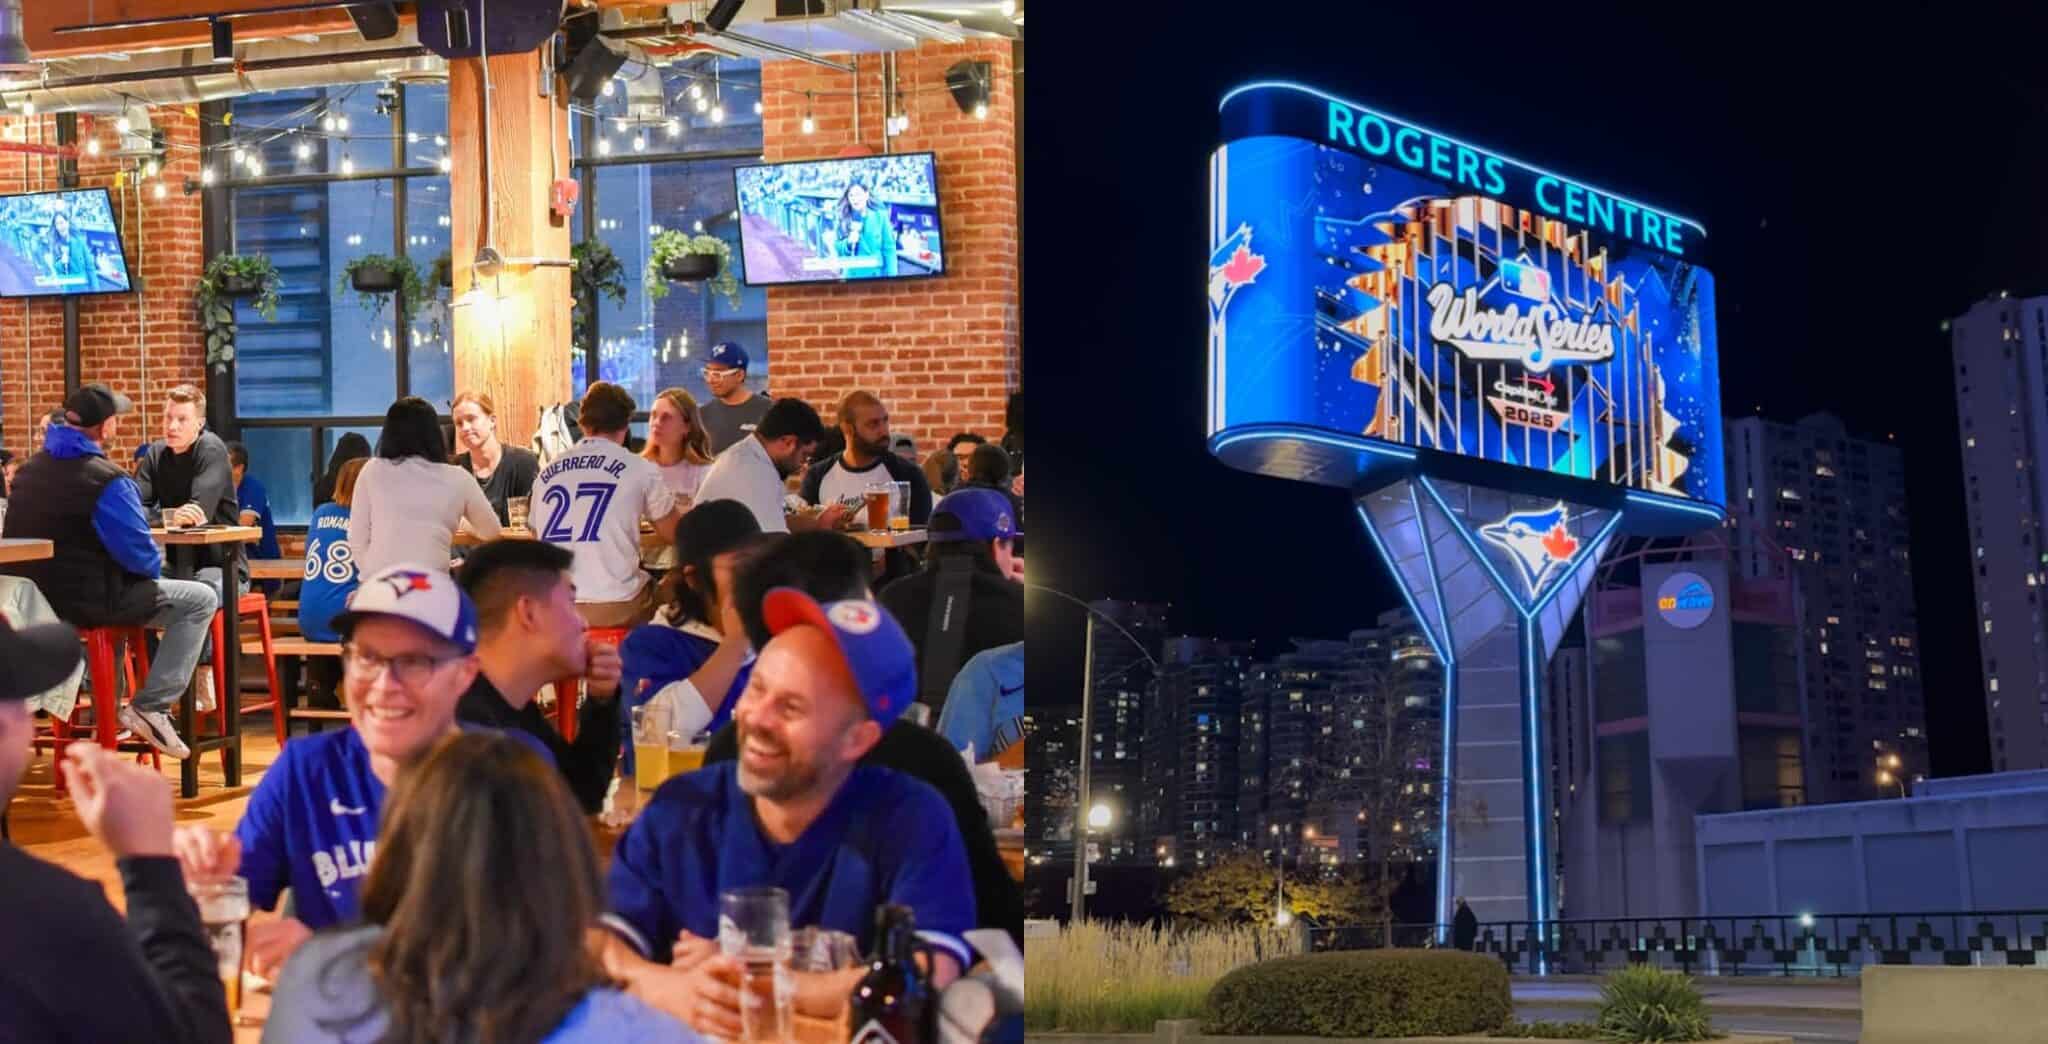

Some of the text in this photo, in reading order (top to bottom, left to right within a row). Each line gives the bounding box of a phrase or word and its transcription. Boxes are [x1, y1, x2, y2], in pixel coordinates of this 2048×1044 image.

[1328, 101, 1685, 254] ROGERS CENTRE
[1427, 283, 1616, 372] World Series
[1504, 405, 1553, 428] 2025
[540, 455, 627, 484] GUERRERO JR.
[317, 515, 351, 531] ROMAN
[542, 482, 618, 542] 27
[304, 537, 354, 584] 68
[311, 839, 377, 888] BLU
